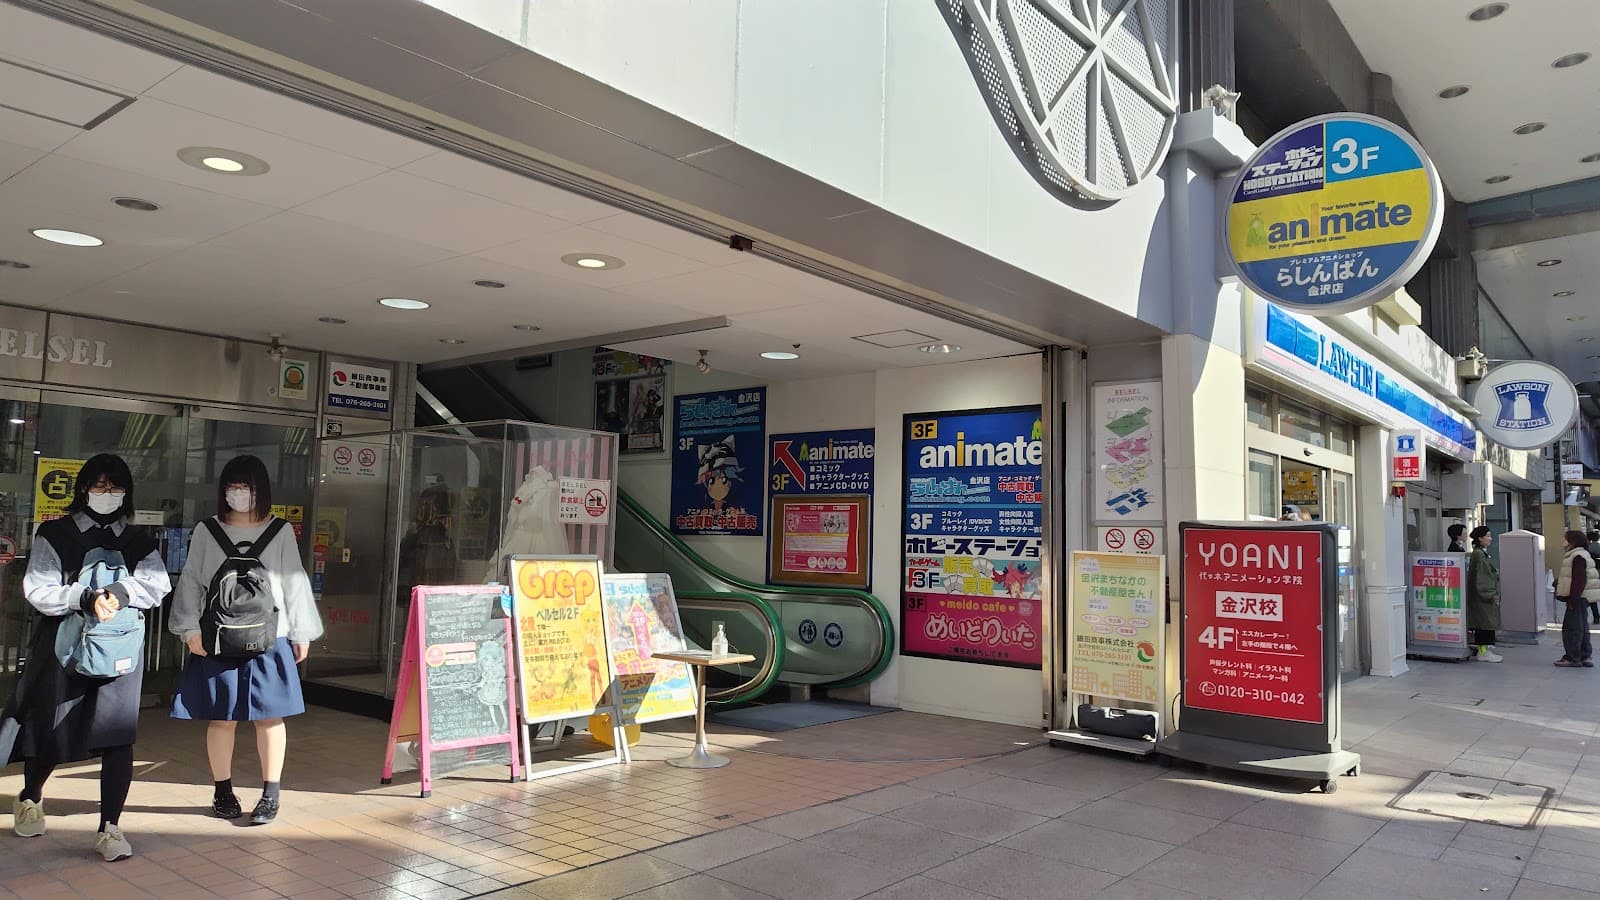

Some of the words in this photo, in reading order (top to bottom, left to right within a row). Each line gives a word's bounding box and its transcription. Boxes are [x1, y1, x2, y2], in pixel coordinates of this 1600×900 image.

[1285, 145, 1323, 160] ホビー
[1331, 138, 1380, 174] 3F
[1251, 156, 1323, 178] ステーション
[1243, 168, 1324, 191] HOBBYSTATION
[1335, 202, 1357, 210] favorite
[1358, 200, 1375, 208] space
[1268, 201, 1412, 244] animate
[1289, 251, 1364, 266] プレミアムアニメショップ
[1276, 259, 1379, 287] らしんばん
[1307, 283, 1344, 296] 金沢店
[1319, 334, 1374, 397] LAWSON
[1497, 382, 1547, 395] LAWSON
[331, 396, 344, 404] TEL
[738, 392, 760, 403] 金沢店
[1107, 395, 1149, 403] INFORMATION
[1499, 416, 1547, 428] STATION
[914, 422, 935, 438] 3F
[679, 437, 694, 451] 3F
[809, 438, 875, 461] animate
[919, 432, 1042, 469] animate
[816, 464, 841, 473] コミック
[1394, 467, 1419, 478] たばこ
[772, 473, 791, 491] 3F
[815, 472, 870, 481] キャラクターグッズ
[969, 476, 991, 485] 金沢店
[49, 474, 68, 495] 占
[998, 482, 1034, 493] 中古買取
[910, 513, 933, 530] 3F
[941, 525, 990, 533] キャラクターグッズ
[906, 537, 1042, 557] ホビーステーショ
[1198, 542, 1303, 570] YOANI
[943, 556, 974, 574] 販売
[1423, 567, 1449, 577] 銀行
[518, 561, 596, 606] Grep
[913, 571, 940, 589] 3F
[963, 577, 993, 595] 買取
[1081, 572, 1147, 587] 金沢まちなかの
[1199, 571, 1304, 586] 代々木アニメーション学院
[1422, 576, 1450, 587] ATM
[908, 597, 924, 609] 3F
[982, 601, 1007, 612] cafe
[1221, 596, 1279, 616] 金沢校
[1198, 625, 1235, 650] 4F
[1212, 667, 1237, 677] マンガ科
[1242, 670, 1289, 682] アニメーター科
[1258, 664, 1292, 674] イラスト科
[1217, 684, 1305, 705] 0120-310-042
